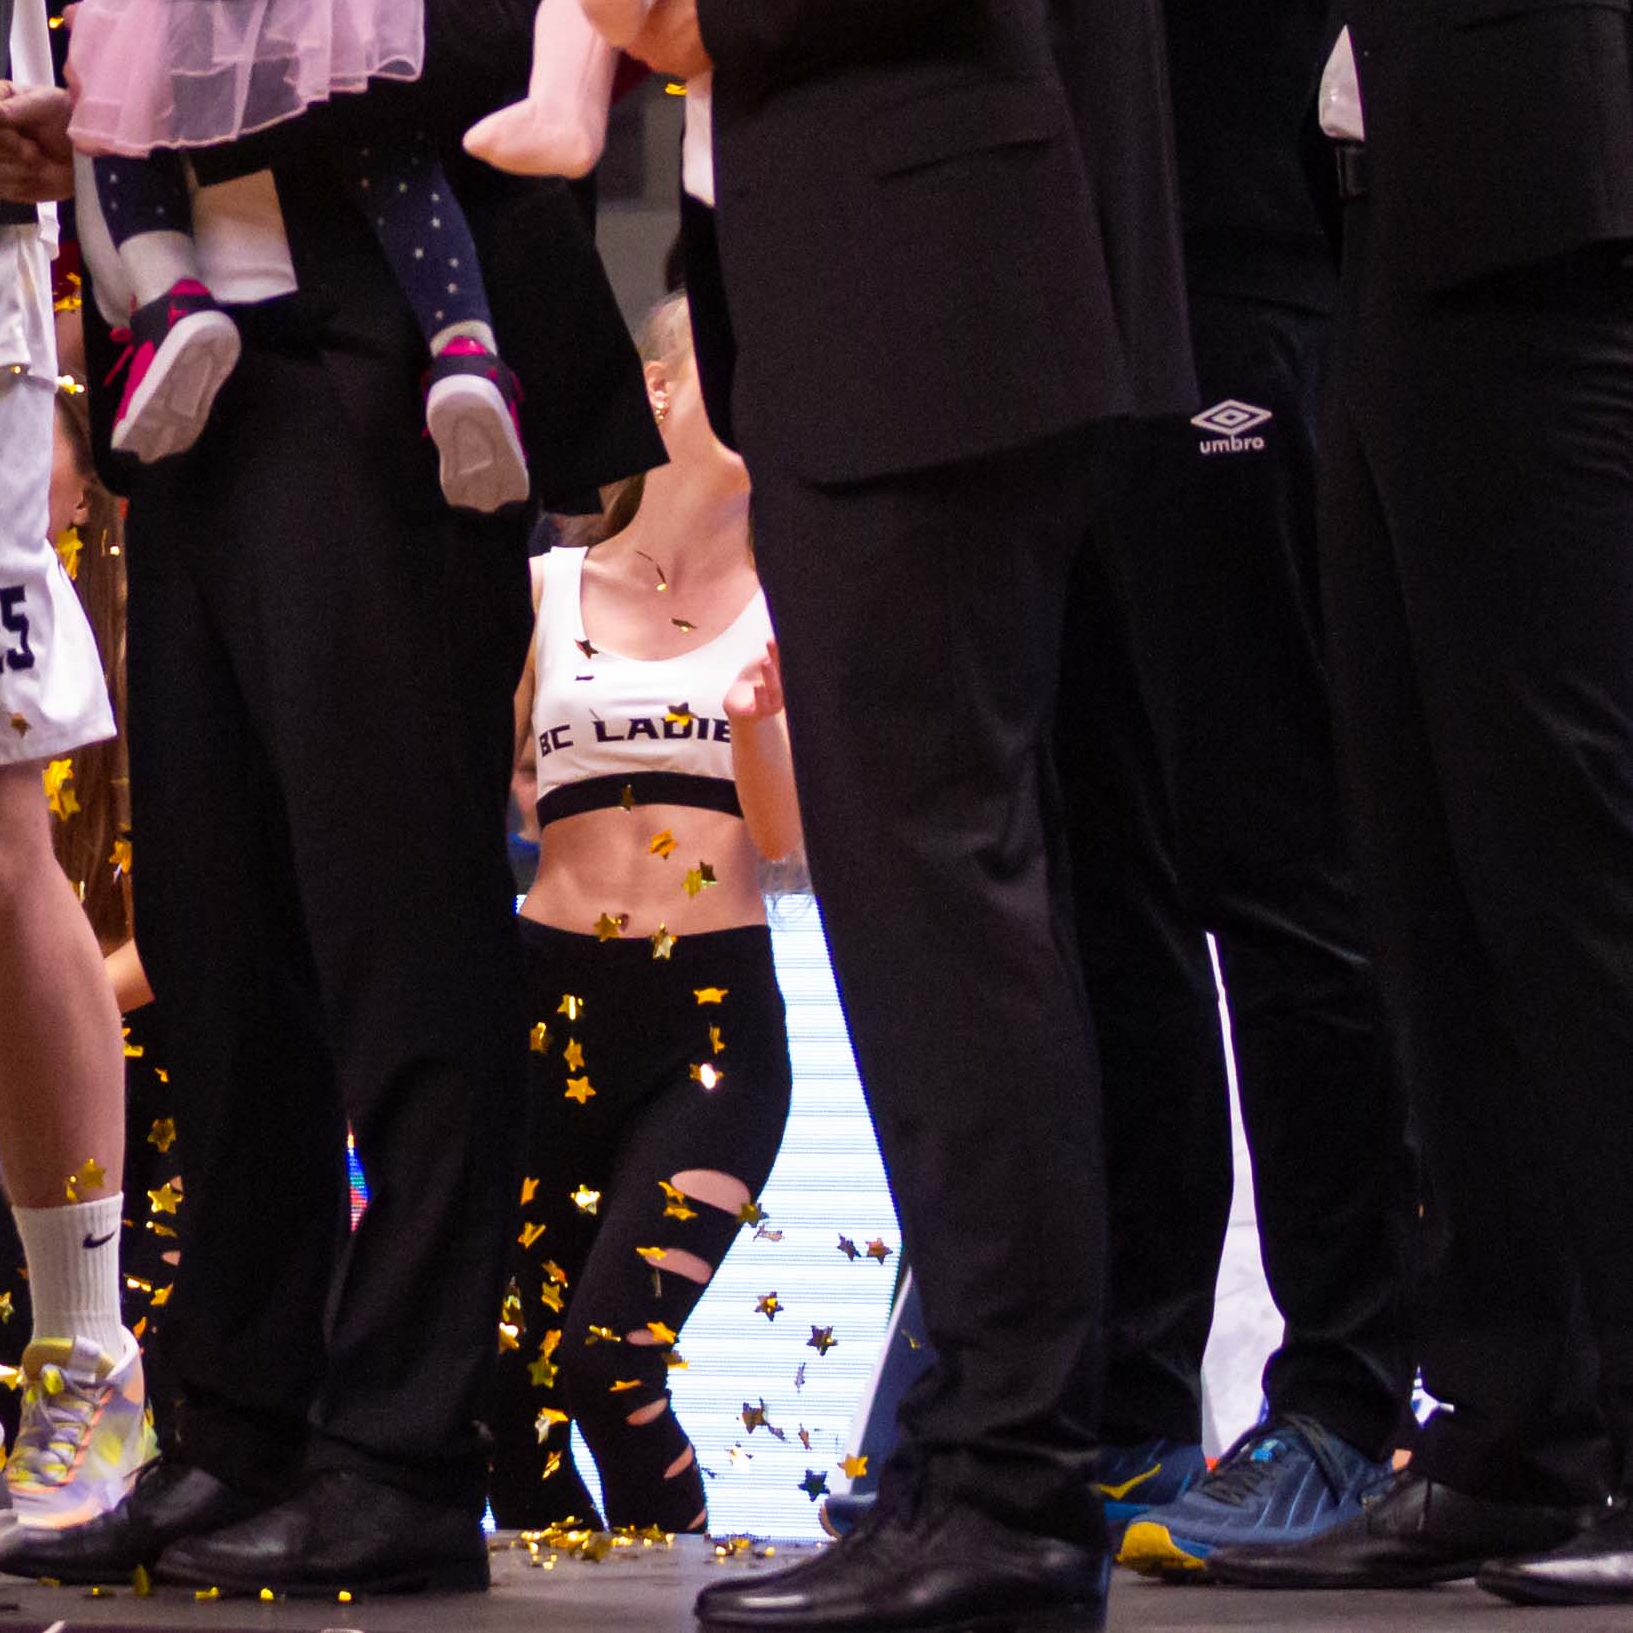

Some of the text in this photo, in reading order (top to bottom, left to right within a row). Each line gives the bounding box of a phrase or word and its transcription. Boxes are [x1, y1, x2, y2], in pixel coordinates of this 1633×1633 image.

[1199, 434, 1265, 455] umbro
[539, 717, 731, 757] BC LADIE
